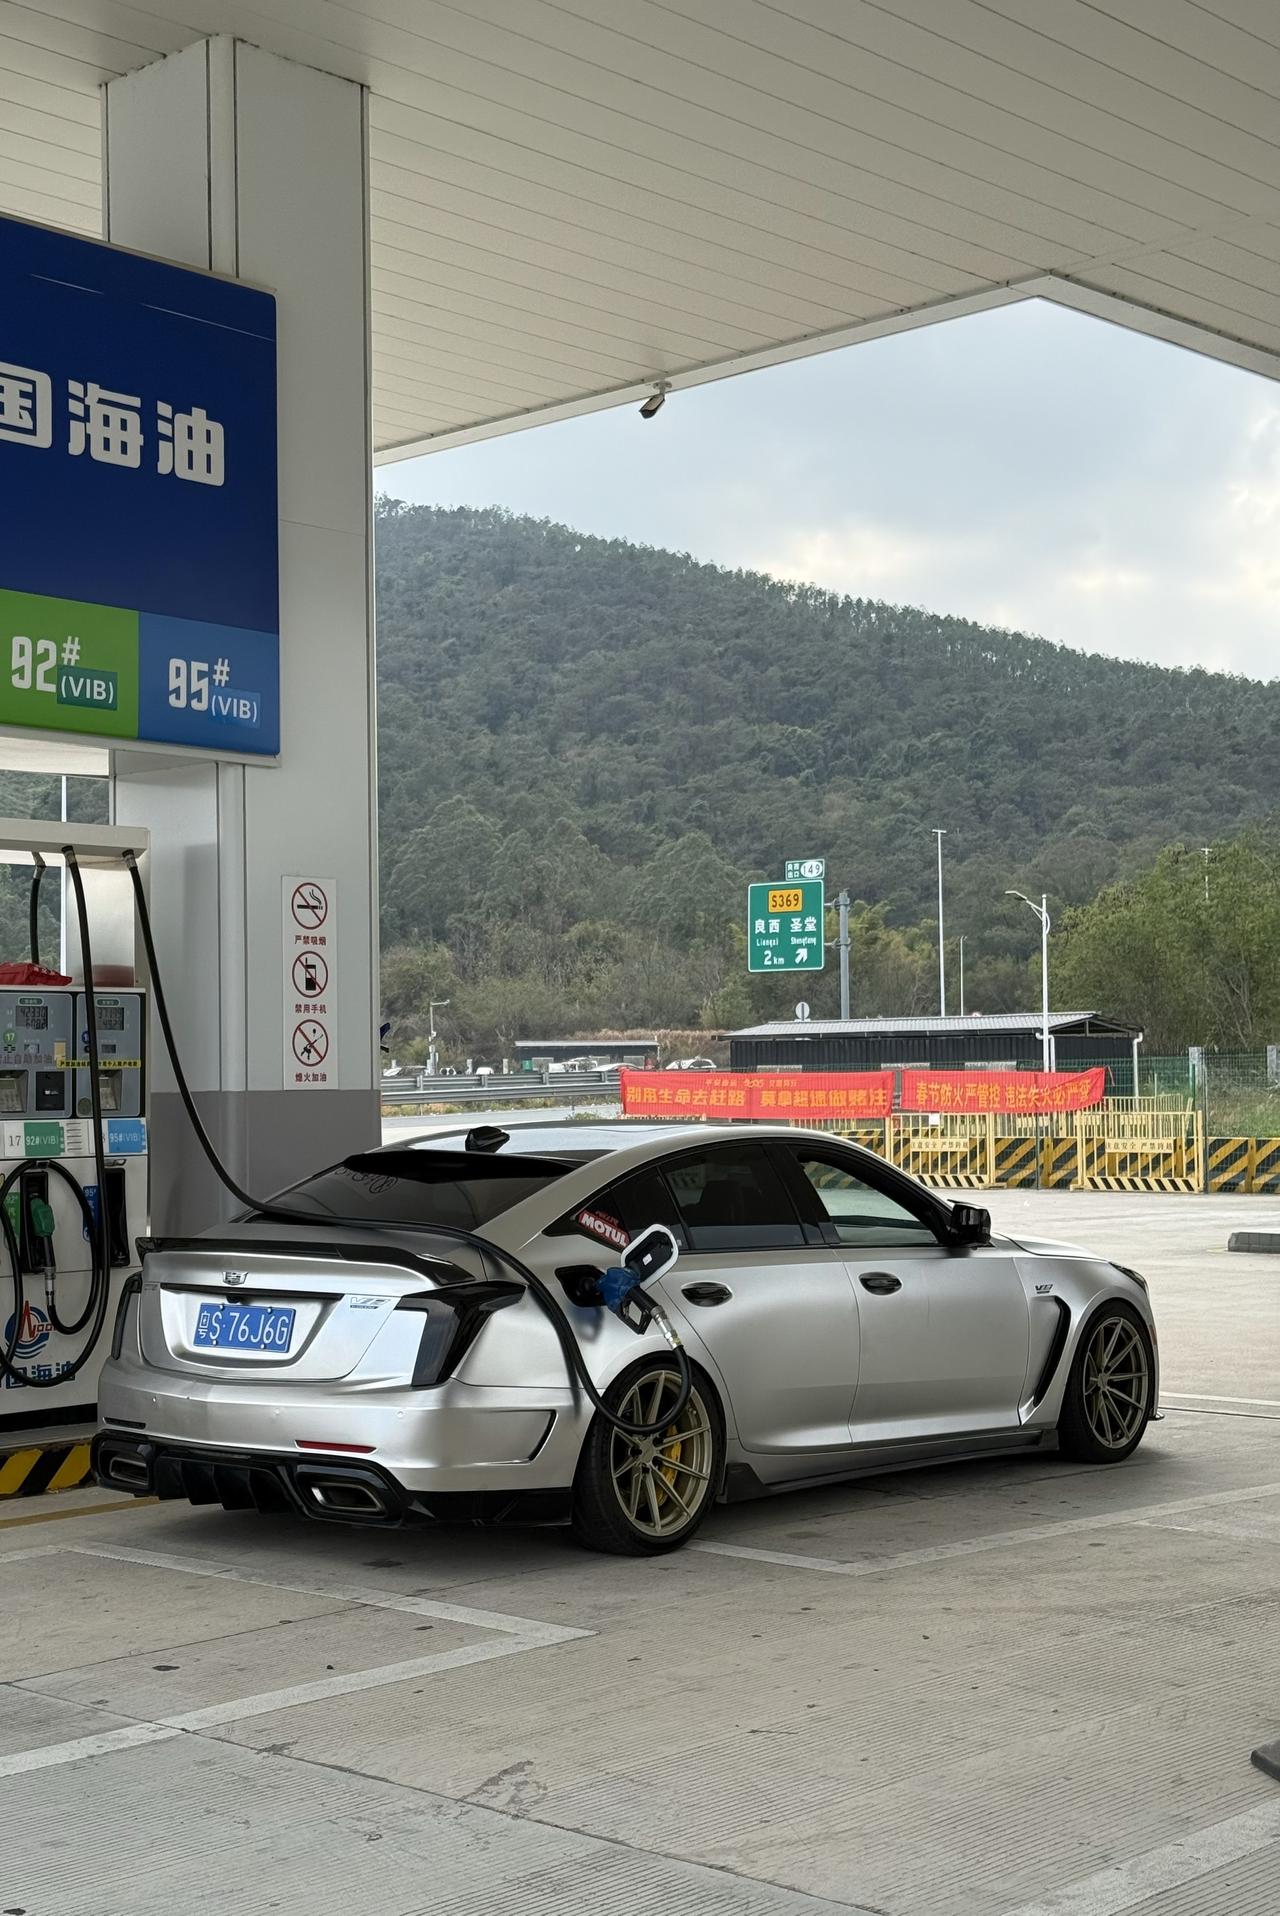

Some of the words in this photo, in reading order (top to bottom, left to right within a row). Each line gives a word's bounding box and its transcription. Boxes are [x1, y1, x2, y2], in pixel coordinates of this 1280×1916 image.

[0, 361, 225, 487] 国海油
[11, 635, 81, 693] 92#
[60, 675, 115, 704] (VIB)
[168, 658, 231, 712] 95#
[211, 695, 258, 723] (VIB)
[804, 864, 820, 876] 149
[772, 894, 799, 908] S369
[755, 919, 780, 934] 良西
[790, 916, 816, 932] 圣堂
[294, 935, 327, 946] 严禁吸烟
[764, 950, 772, 965] 2
[773, 957, 784, 965] km
[294, 1003, 327, 1014] 禁用手机
[5, 1032, 16, 1042] 17
[295, 1072, 327, 1082] 熄火加油
[626, 1086, 745, 1106] 别用生命去赶路
[916, 1080, 1000, 1108] 春节防火严管控
[9, 1135, 21, 1147] 17
[581, 1213, 627, 1248] MOTUL
